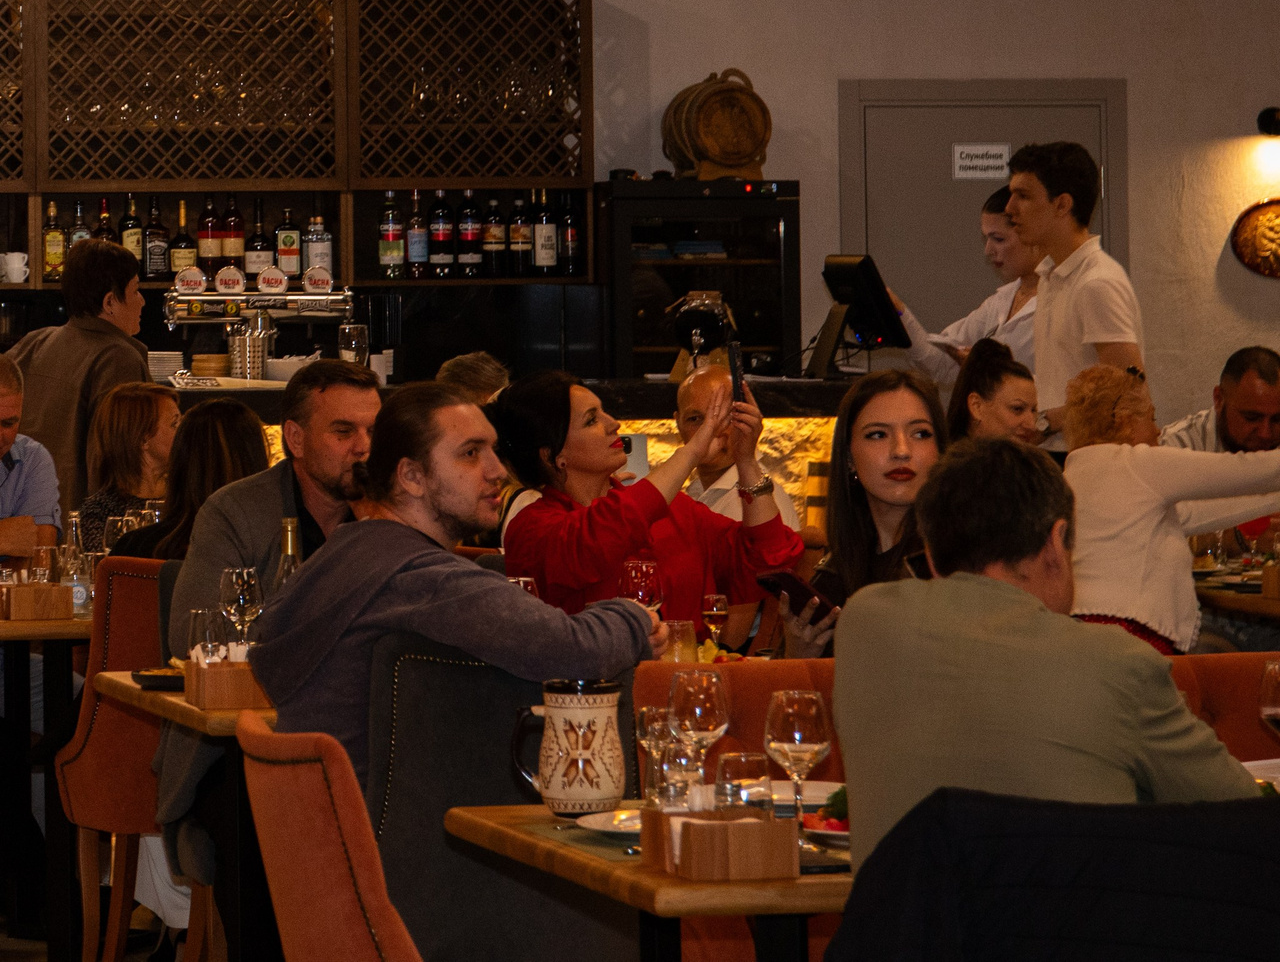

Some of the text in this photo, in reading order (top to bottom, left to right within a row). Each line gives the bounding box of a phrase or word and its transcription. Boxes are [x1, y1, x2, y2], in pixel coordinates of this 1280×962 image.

[959, 150, 1004, 161] Служебное
[959, 164, 1005, 173] помещение
[219, 278, 240, 286] DACHA
[262, 277, 283, 286] DACHA
